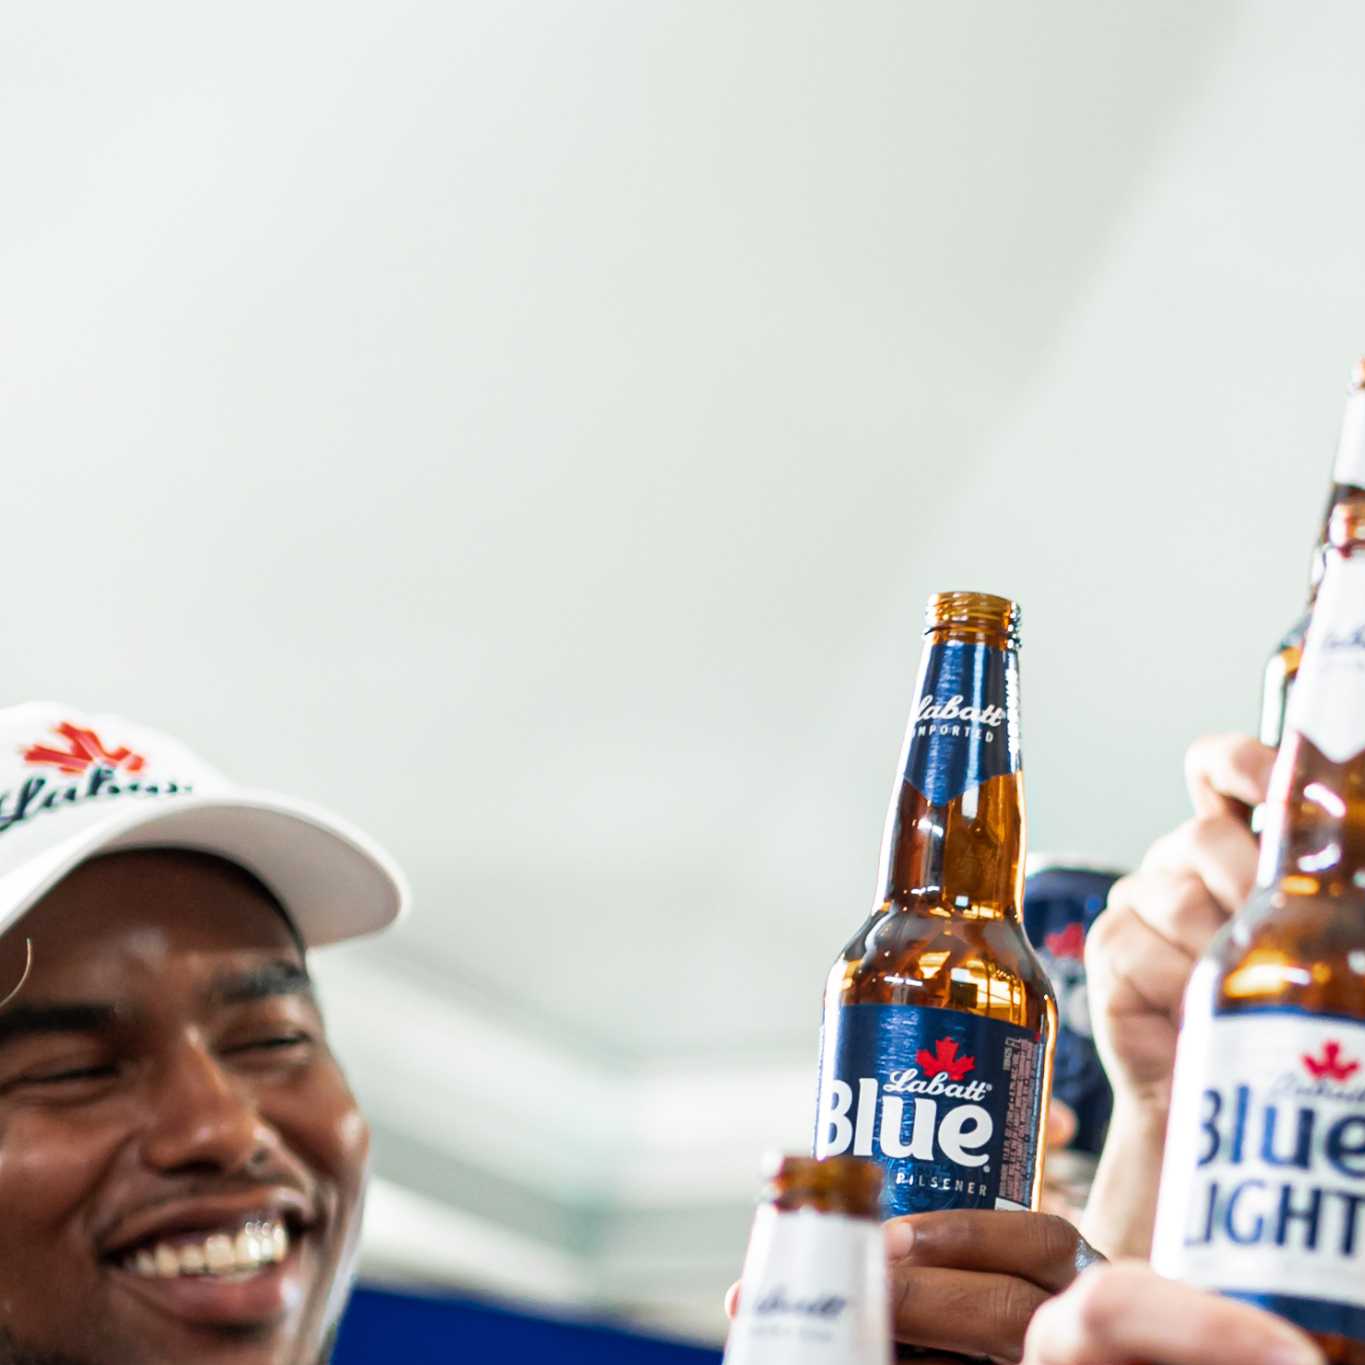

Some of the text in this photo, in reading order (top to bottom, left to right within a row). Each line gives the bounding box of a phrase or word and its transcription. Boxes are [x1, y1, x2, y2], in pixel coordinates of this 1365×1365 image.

[882, 1068, 988, 1102] Labatt
[815, 1077, 994, 1168] Blue
[895, 1171, 989, 1197] PILSENER
